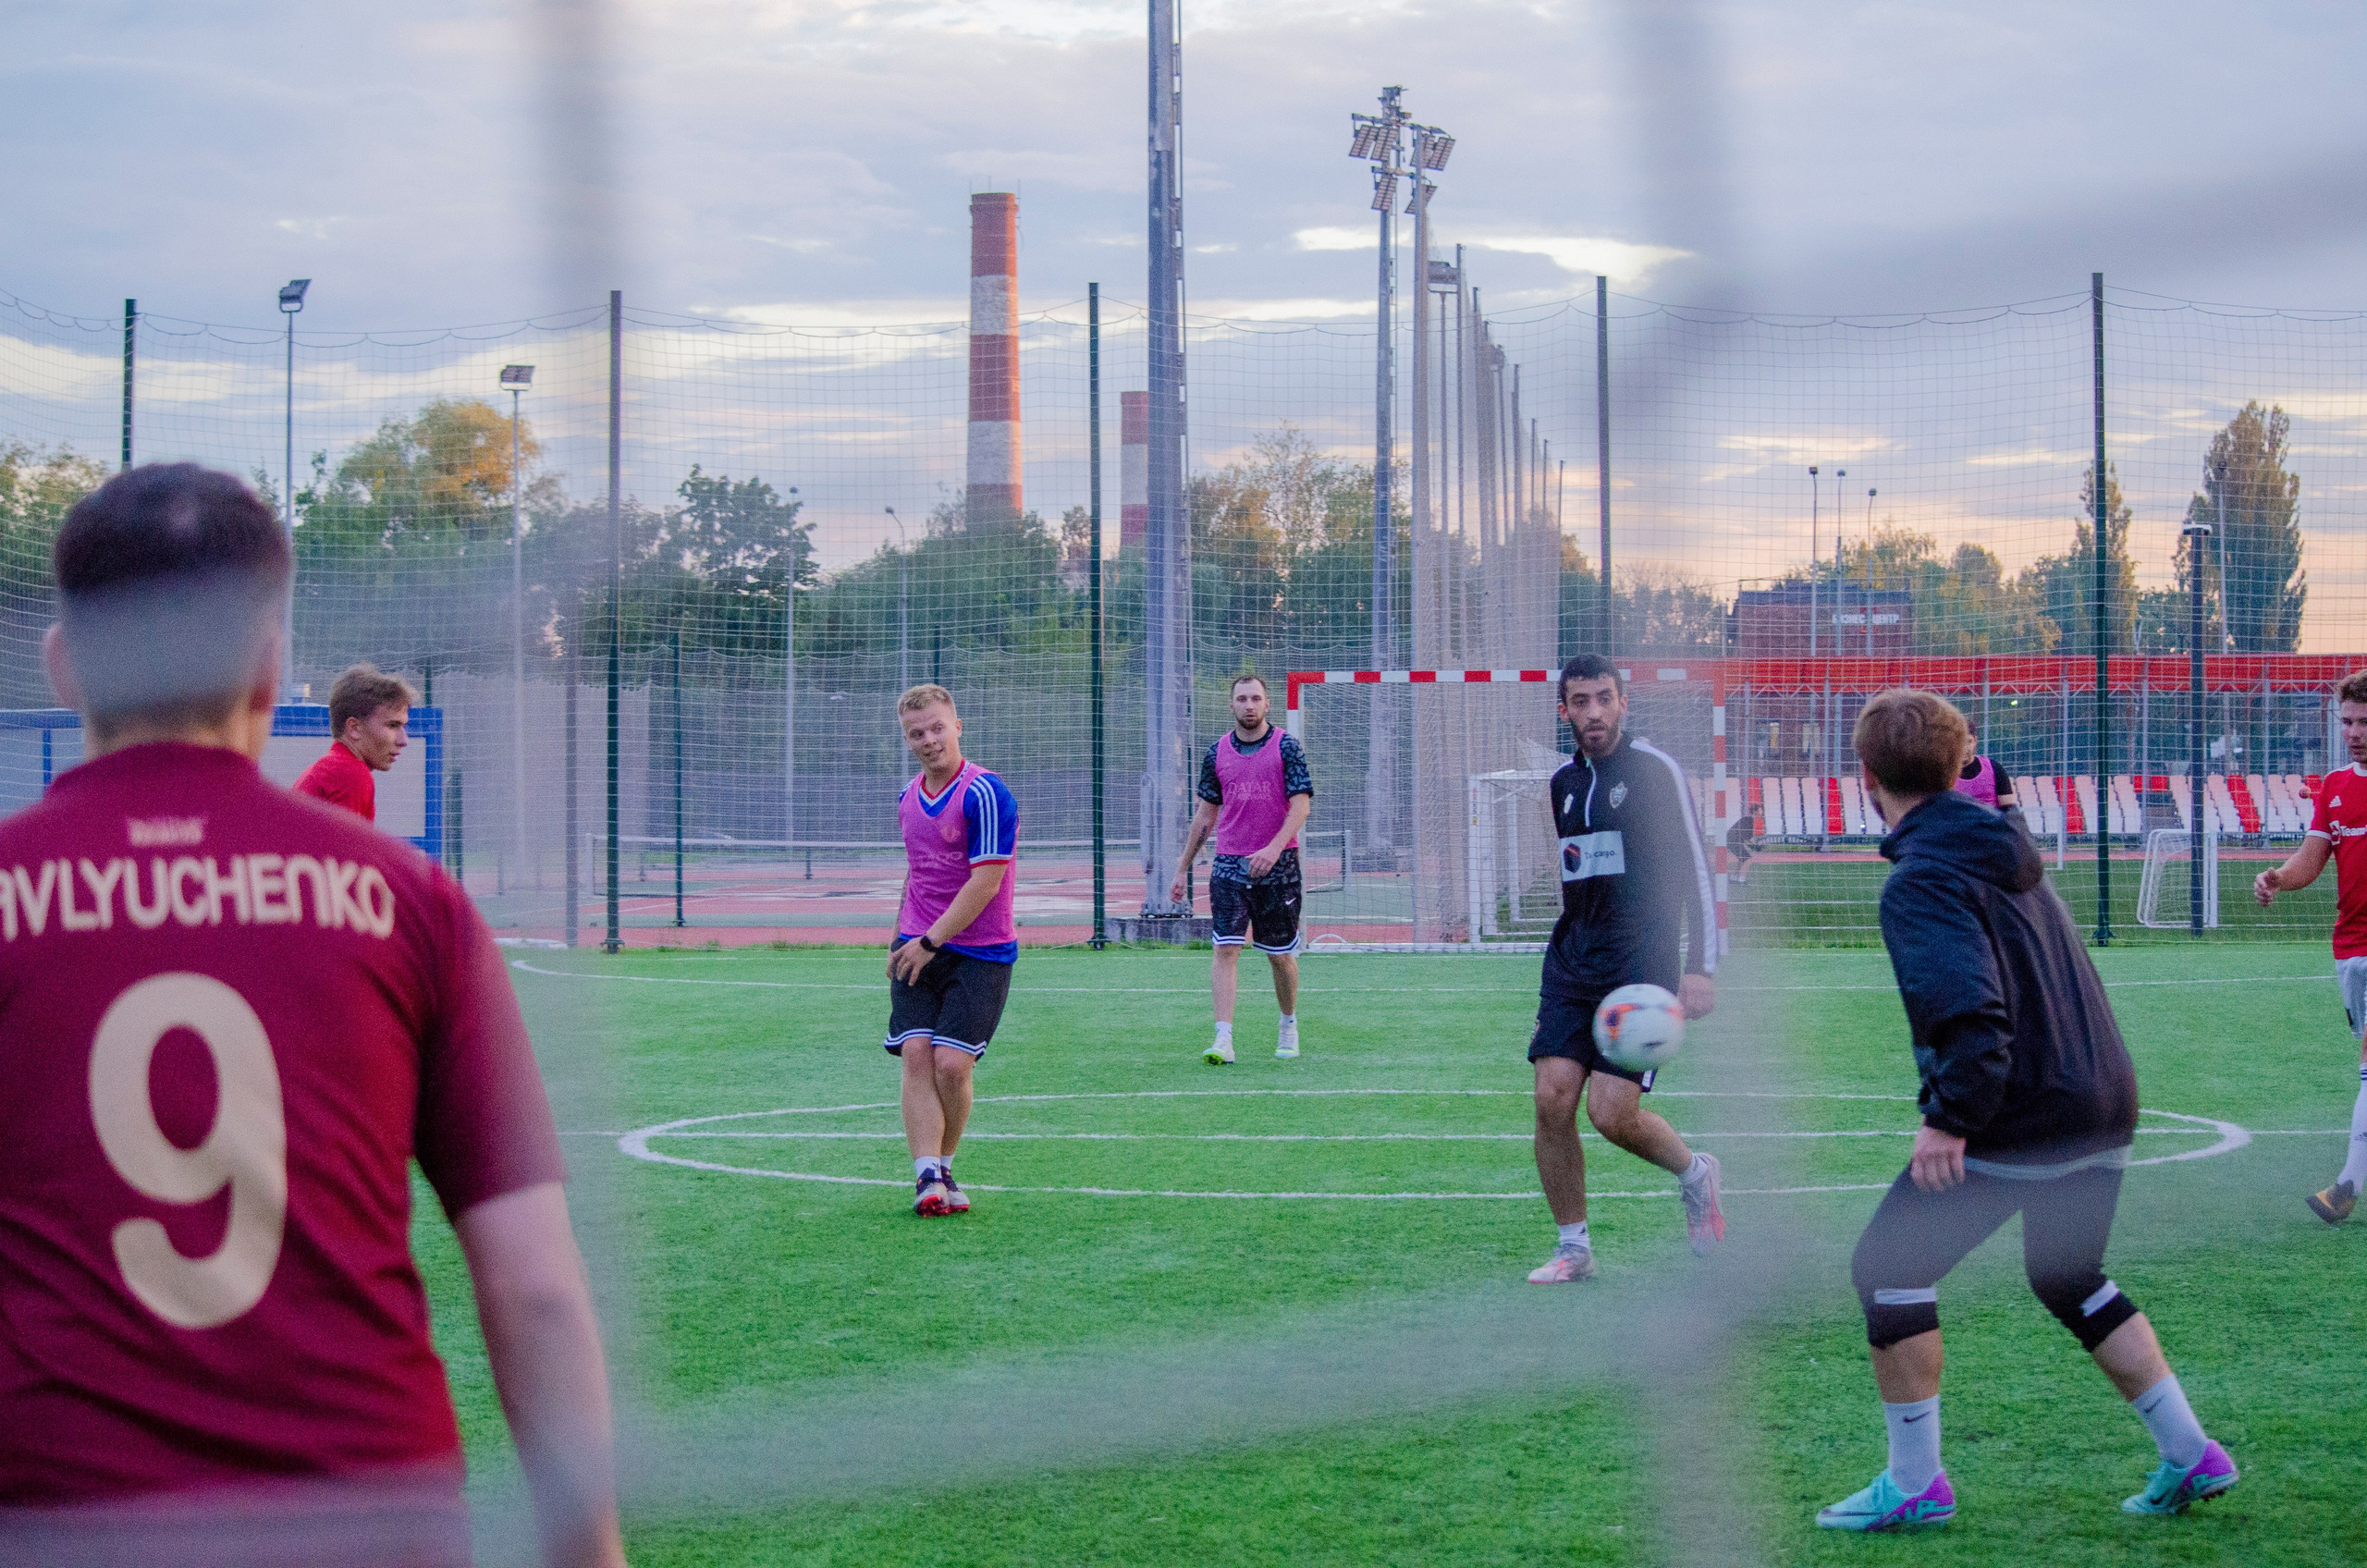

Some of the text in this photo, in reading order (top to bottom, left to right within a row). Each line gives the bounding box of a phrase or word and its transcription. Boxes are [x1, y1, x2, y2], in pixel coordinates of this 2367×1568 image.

[1833, 614, 1866, 624] БЗНЕС
[2340, 825, 2367, 837] Team
[89, 971, 287, 1329] 9
